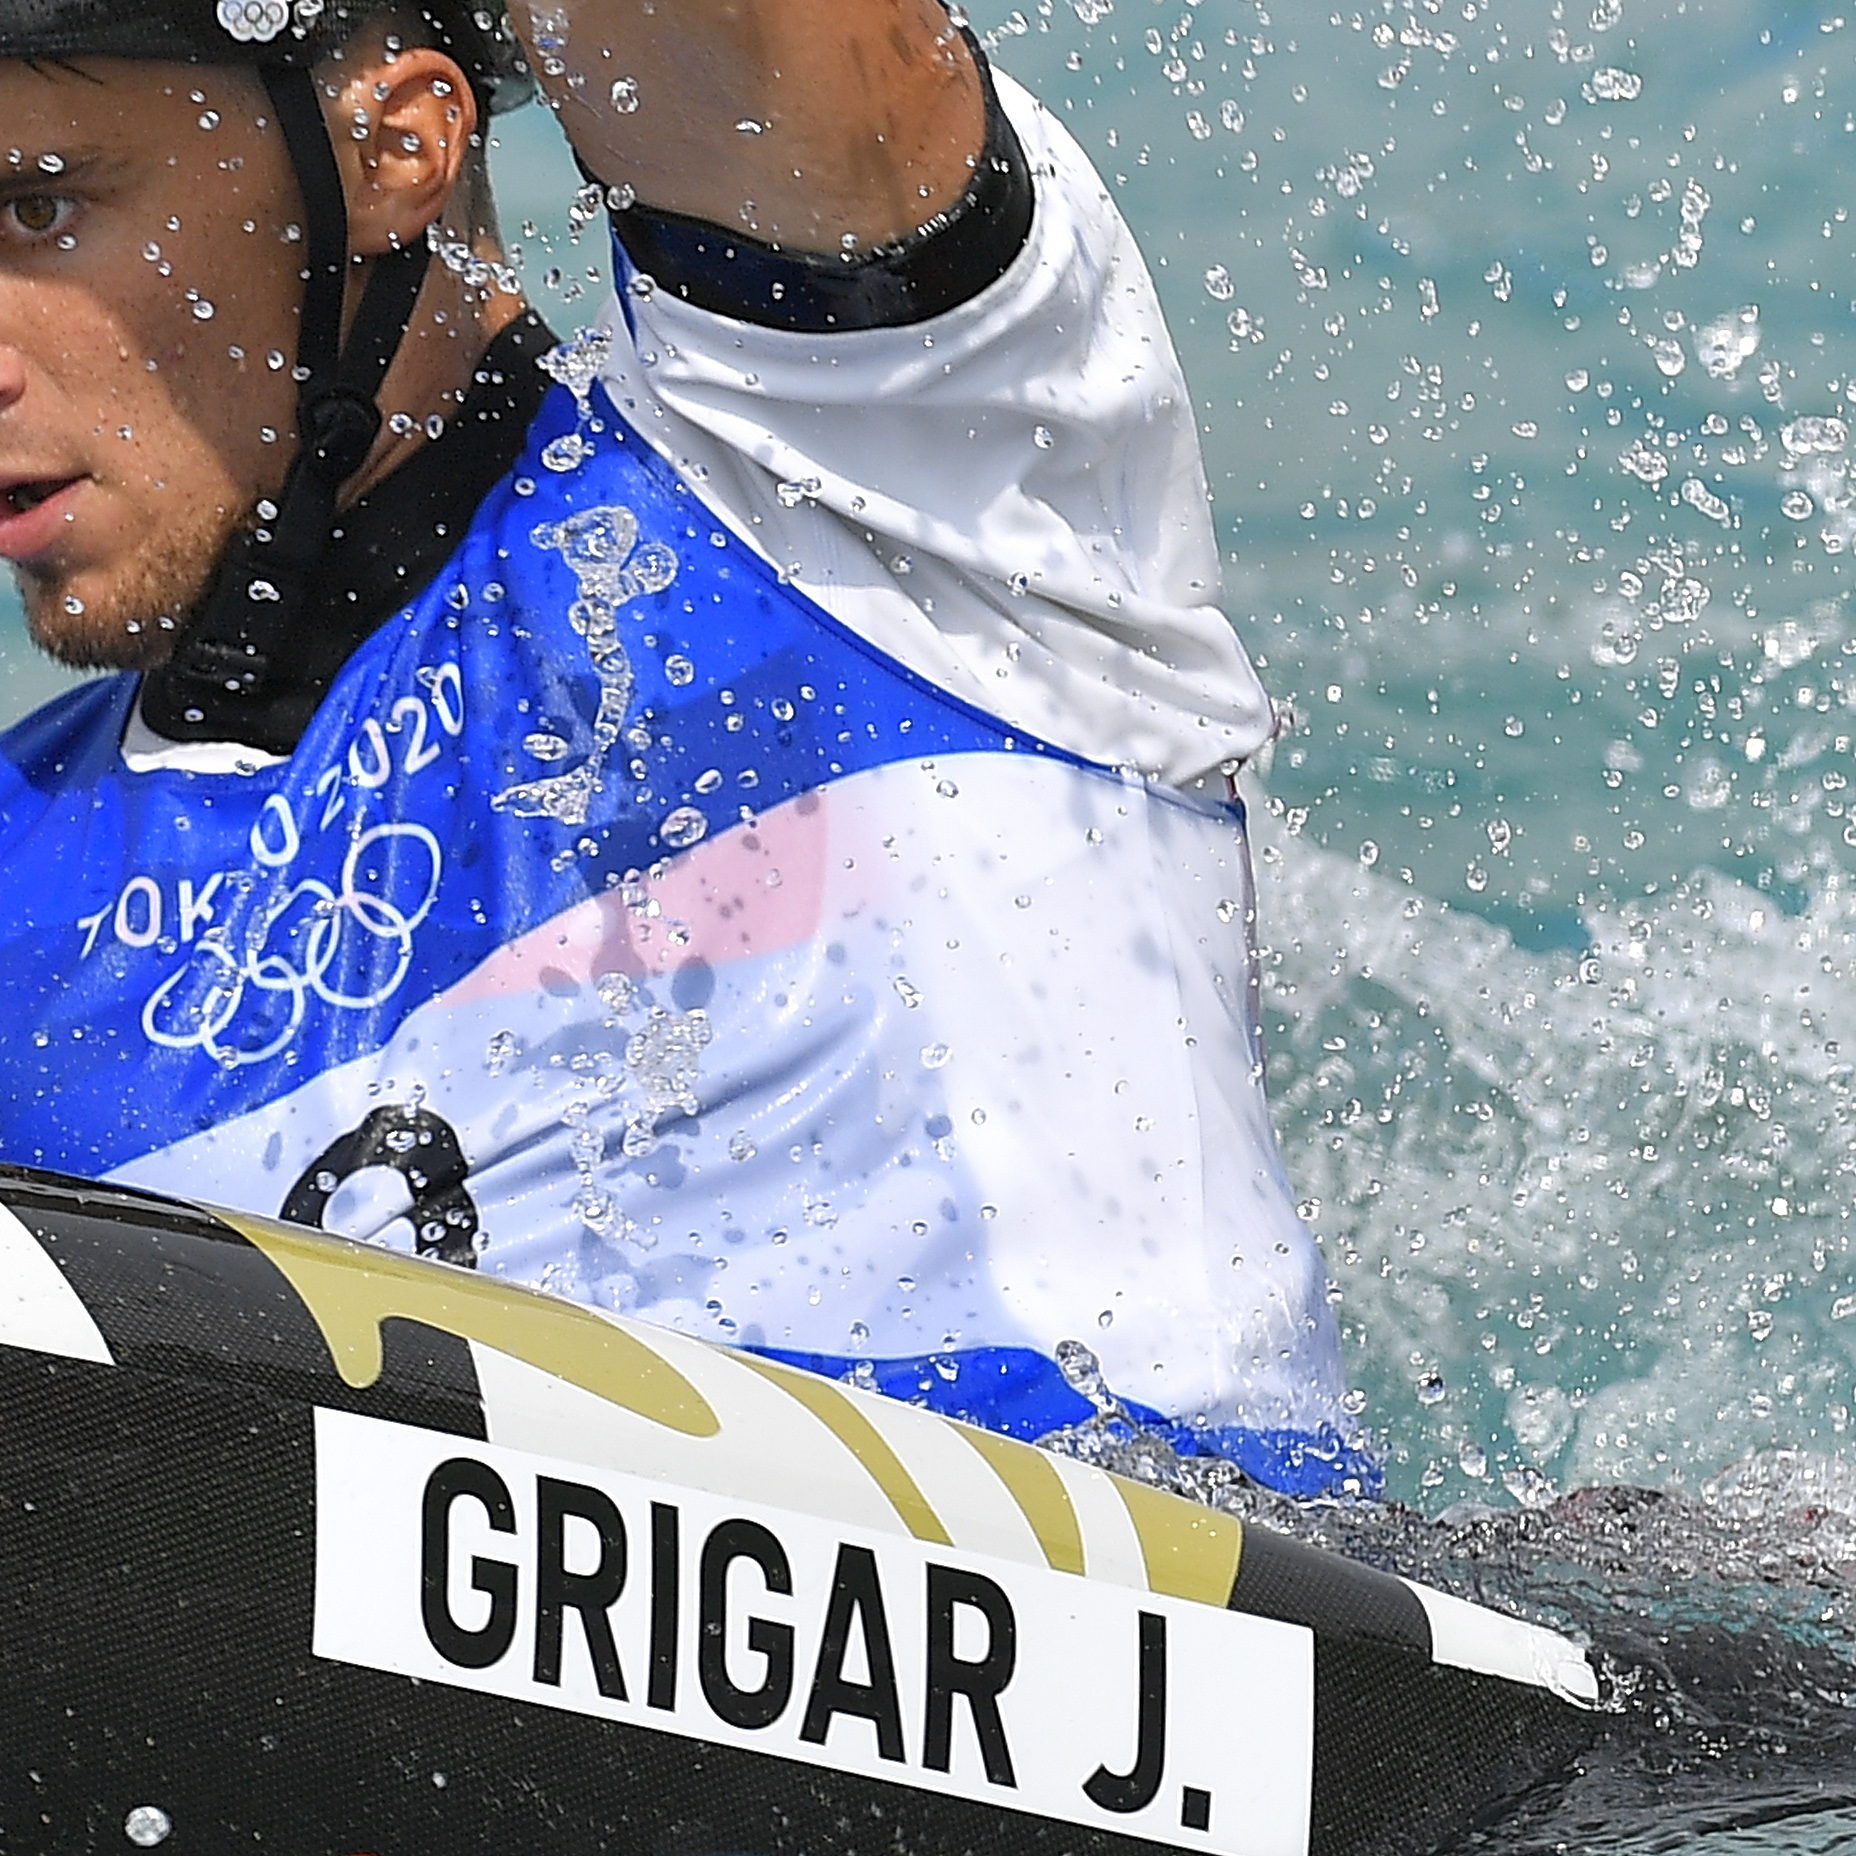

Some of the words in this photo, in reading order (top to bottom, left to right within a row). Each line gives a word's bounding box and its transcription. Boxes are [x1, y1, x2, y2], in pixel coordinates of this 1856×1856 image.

[78, 794, 300, 959] TOKO
[316, 662, 464, 832] 2020
[419, 1456, 1019, 1791] GRIGAR
[1081, 1611, 1213, 1833] J.
